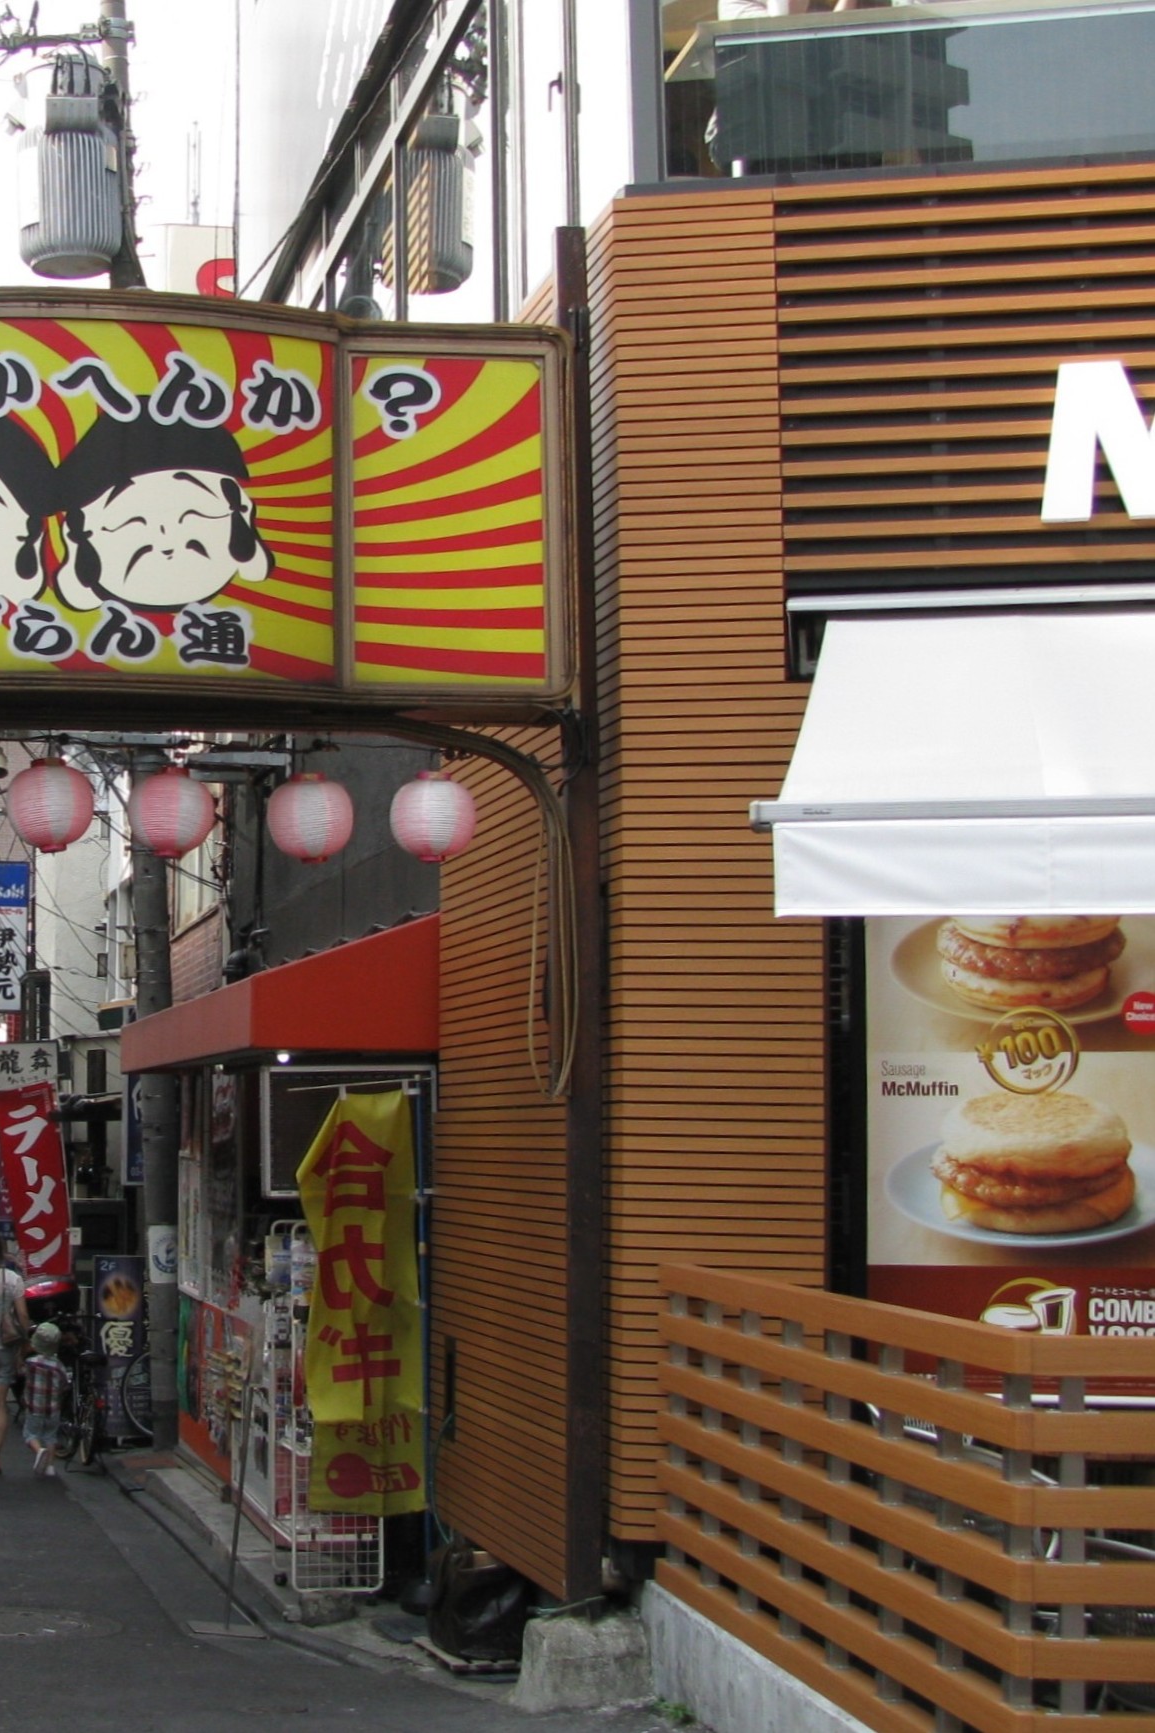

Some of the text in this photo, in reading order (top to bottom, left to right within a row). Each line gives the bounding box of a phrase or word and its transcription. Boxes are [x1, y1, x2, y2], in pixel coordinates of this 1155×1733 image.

[881, 1060, 927, 1079] Sausage
[880, 1080, 959, 1098] McMuffin
[3, 1104, 63, 1268] ラーメン
[99, 1259, 116, 1271] 2F
